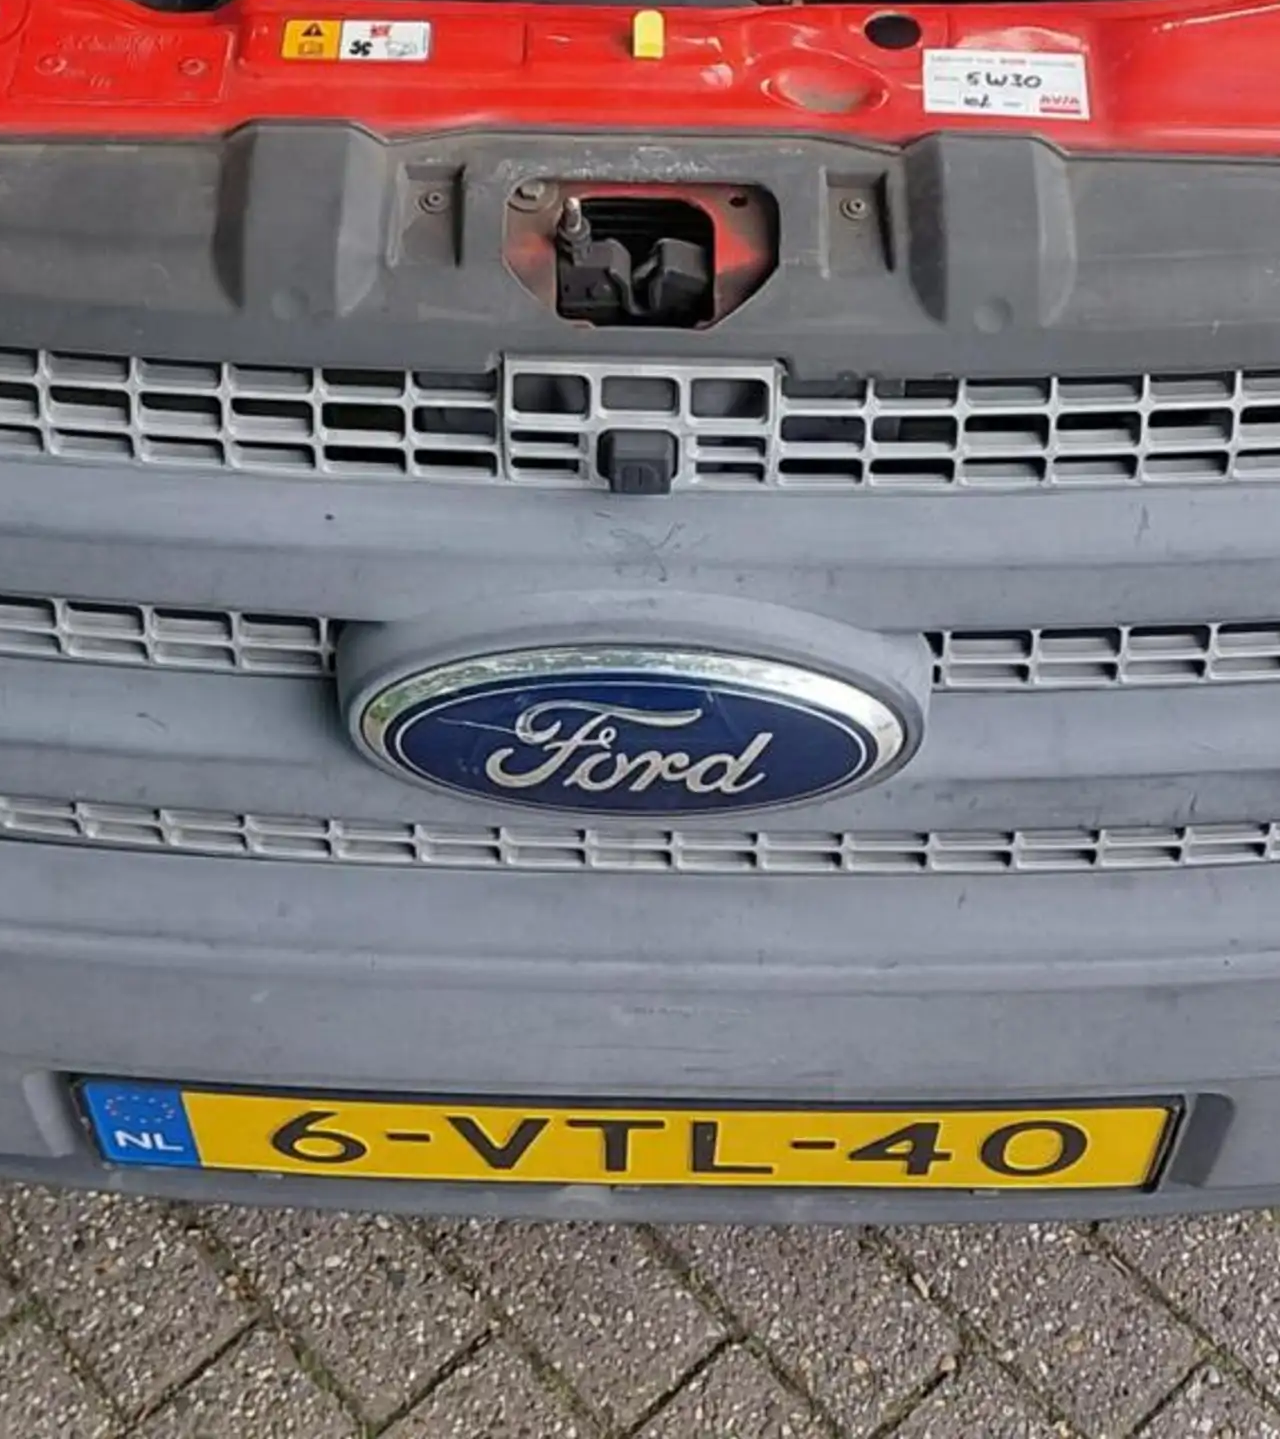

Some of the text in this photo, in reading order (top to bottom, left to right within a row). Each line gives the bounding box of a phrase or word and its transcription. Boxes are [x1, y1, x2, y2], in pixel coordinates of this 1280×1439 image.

[485, 700, 773, 794] Ford
[114, 1129, 183, 1152] NL
[271, 1111, 1088, 1177] 6-VTL-40
